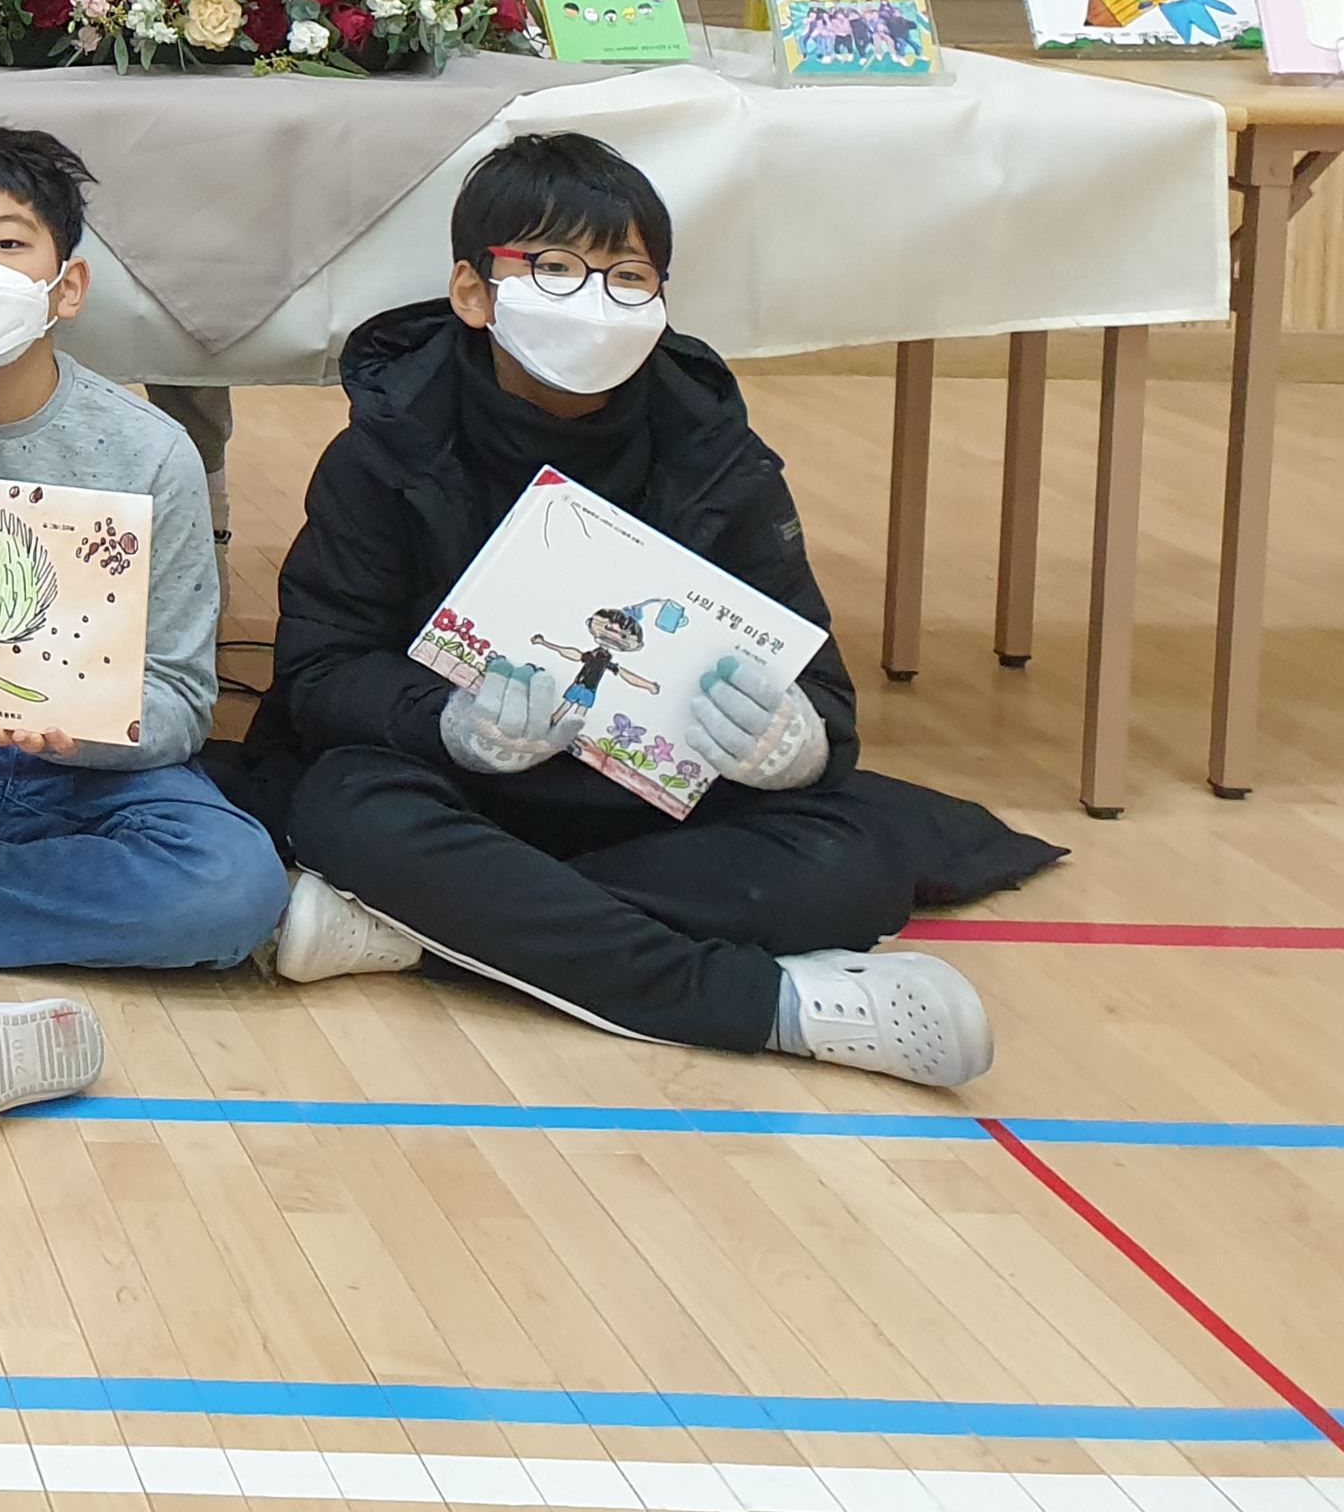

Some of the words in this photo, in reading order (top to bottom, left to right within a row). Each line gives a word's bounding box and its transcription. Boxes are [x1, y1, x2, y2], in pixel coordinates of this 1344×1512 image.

[686, 589, 715, 612] 나의
[716, 604, 744, 631] 꽃밭
[743, 624, 786, 656] 미술관
